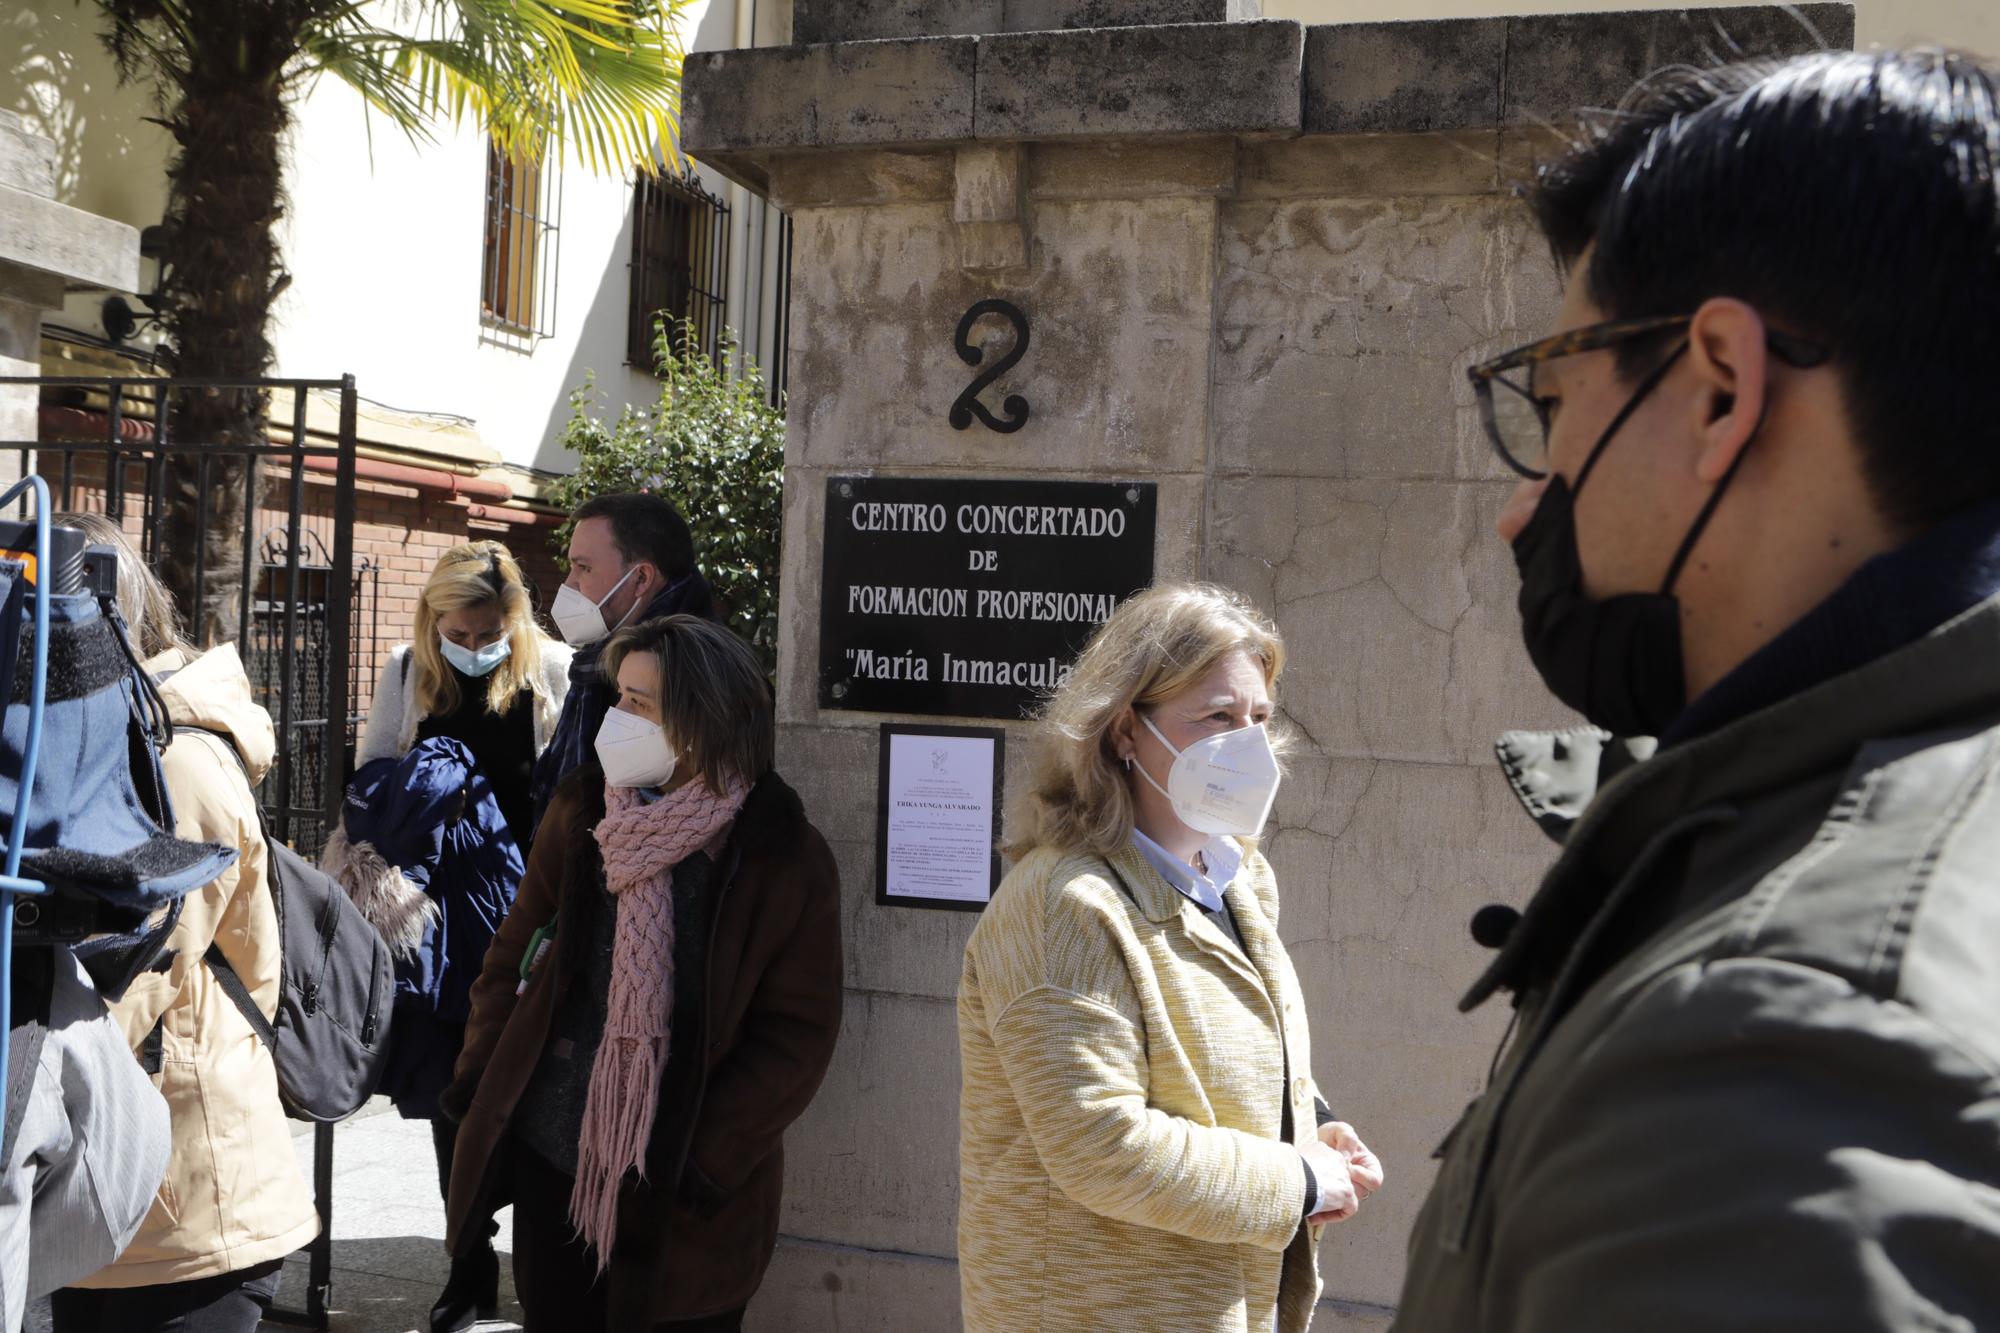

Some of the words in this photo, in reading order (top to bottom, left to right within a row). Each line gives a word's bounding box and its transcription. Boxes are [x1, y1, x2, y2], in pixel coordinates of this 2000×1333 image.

[949, 299, 1030, 434] 2
[851, 502, 947, 532] CENTRO
[957, 504, 1126, 537] CONCERTADO
[968, 550, 998, 571] DE
[848, 585, 968, 617] FORMACION
[846, 648, 929, 681] "María
[942, 653, 1073, 689] Inmacula
[944, 803, 981, 811] ALVARADO
